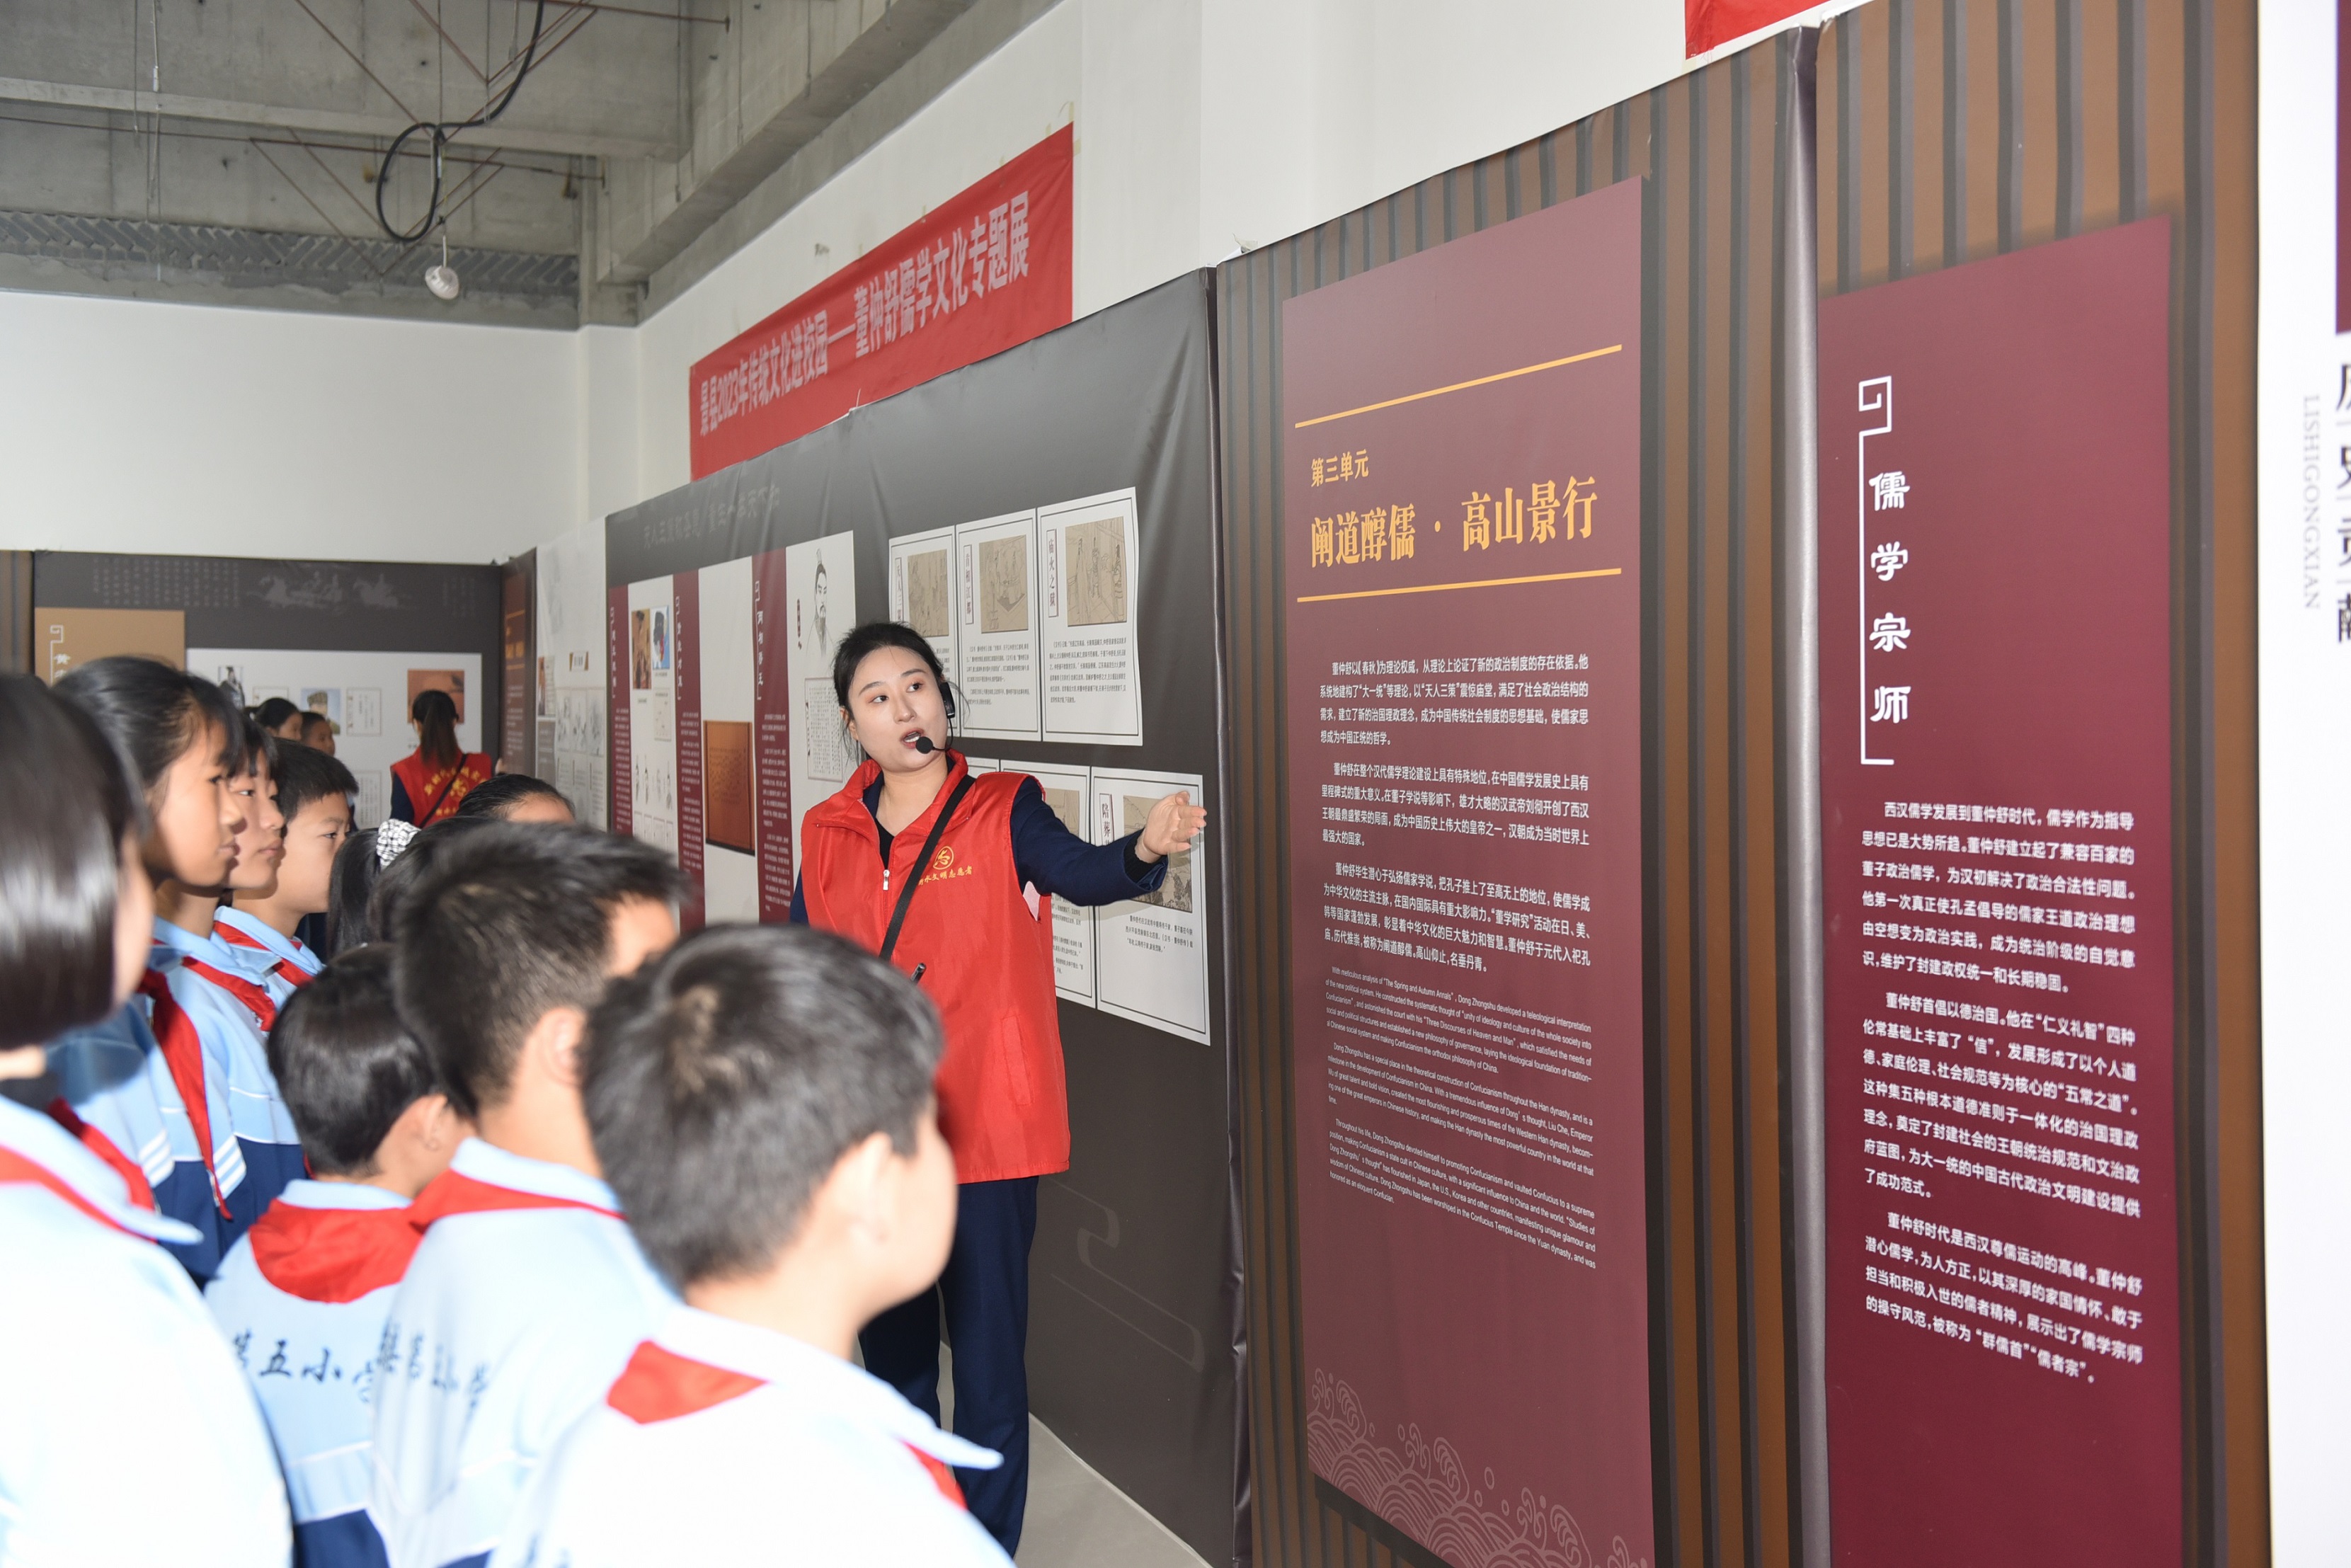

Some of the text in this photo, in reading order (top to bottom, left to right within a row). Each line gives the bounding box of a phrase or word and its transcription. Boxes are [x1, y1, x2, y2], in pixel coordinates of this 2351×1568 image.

[1311, 449, 1368, 487] 第三单元
[2304, 394, 2321, 610] LISHIGONGXIAN
[1869, 470, 1911, 724] 儒学宗师
[1321, 731, 1390, 745] 想成为中国正统的哲学。
[1322, 829, 1364, 846] 最强大的国家。
[1325, 927, 1487, 972] 庙，历代推崇，被称为阐道醇儒。高山仰止，名垂丹青。
[1331, 966, 1341, 975] With
[1341, 969, 1361, 980] meticulous
[1361, 974, 1378, 984] analysis
[1393, 980, 1409, 992] Spring
[1417, 985, 1436, 997] Autumn
[1458, 994, 1471, 1007] Dong
[1471, 997, 1496, 1010] Zhongshu
[1496, 1003, 1521, 1017] developed
[1526, 1010, 1555, 1024] teleological
[1556, 1016, 1591, 1033] interpretation
[1363, 1002, 1386, 1014] astonished
[1393, 1010, 1405, 1019] court
[1405, 1013, 1415, 1022] with
[1439, 1020, 1466, 1034] Discourses
[1466, 1027, 1472, 1036] of
[1472, 1028, 1492, 1040] Heaven
[1492, 1034, 1502, 1043] and
[1519, 1041, 1535, 1051] which
[1535, 1046, 1558, 1058] satisfied
[1558, 1050, 1568, 1060] the
[1568, 1053, 1585, 1065] needs
[1585, 1057, 1591, 1066] of
[1327, 1068, 1334, 1076] Wu
[1338, 1072, 1349, 1081] great
[1349, 1075, 1360, 1085] talent
[1360, 1079, 1368, 1087] and
[1368, 1080, 1378, 1090] bold
[1378, 1085, 1390, 1096] vision,
[1390, 1089, 1407, 1099] created
[1415, 1097, 1426, 1106] most
[1426, 1099, 1450, 1115] flourishing
[1450, 1107, 1459, 1116] and
[1460, 1111, 1487, 1125] prosperous
[1487, 1118, 1501, 1129] times
[1501, 1122, 1507, 1131] of
[1515, 1126, 1537, 1140] Western
[1538, 1133, 1549, 1145] Han
[1549, 1138, 1571, 1153] dynasty,
[1572, 1145, 1594, 1158] becom-
[1333, 1042, 1344, 1053] Dong
[1344, 1045, 1363, 1058] Zhongshu
[1374, 1055, 1388, 1065] special
[1388, 1059, 1400, 1069] place
[1400, 1062, 1405, 1070] in
[1413, 1065, 1436, 1079] theoretical
[1436, 1073, 1464, 1087] construction
[1464, 1080, 1470, 1089] of
[1470, 1082, 1502, 1098] Confucianism
[1502, 1091, 1528, 1106] throughout
[1528, 1099, 1538, 1109] the
[1538, 1101, 1549, 1112] Han
[1549, 1105, 1572, 1121] dynasty,
[1572, 1113, 1582, 1123] and
[1583, 1115, 1588, 1124] is
[1329, 1143, 1339, 1155] Dong
[1382, 1163, 1390, 1173] has
[1390, 1166, 1411, 1181] flourished
[1411, 1174, 1416, 1183] in
[1417, 1177, 1431, 1190] Japan,
[1431, 1182, 1440, 1192] the
[1440, 1185, 1451, 1198] U.S.,
[1452, 1189, 1466, 1202] Korea
[1467, 1196, 1477, 1206] and
[1477, 1200, 1489, 1211] other
[1489, 1206, 1514, 1221] countries,
[1514, 1215, 1544, 1233] manifesting
[1544, 1226, 1562, 1239] unique
[1562, 1232, 1584, 1247] glamour
[1584, 1242, 1596, 1252] and
[1335, 1118, 1357, 1133] Throughout
[1372, 1131, 1384, 1144] Dong
[1384, 1135, 1405, 1150] Zhongshu
[1405, 1143, 1423, 1157] devoted
[1423, 1150, 1440, 1162] himself
[1440, 1155, 1446, 1164] to
[1446, 1159, 1469, 1174] promoting
[1470, 1166, 1503, 1184] Confucianism
[1504, 1179, 1514, 1189] and
[1514, 1183, 1532, 1196] vaulted
[1532, 1188, 1559, 1206] Confucius
[1559, 1198, 1565, 1208] to
[1570, 1203, 1594, 1218] supreme
[1865, 1168, 1931, 1198] 了成功范式。
